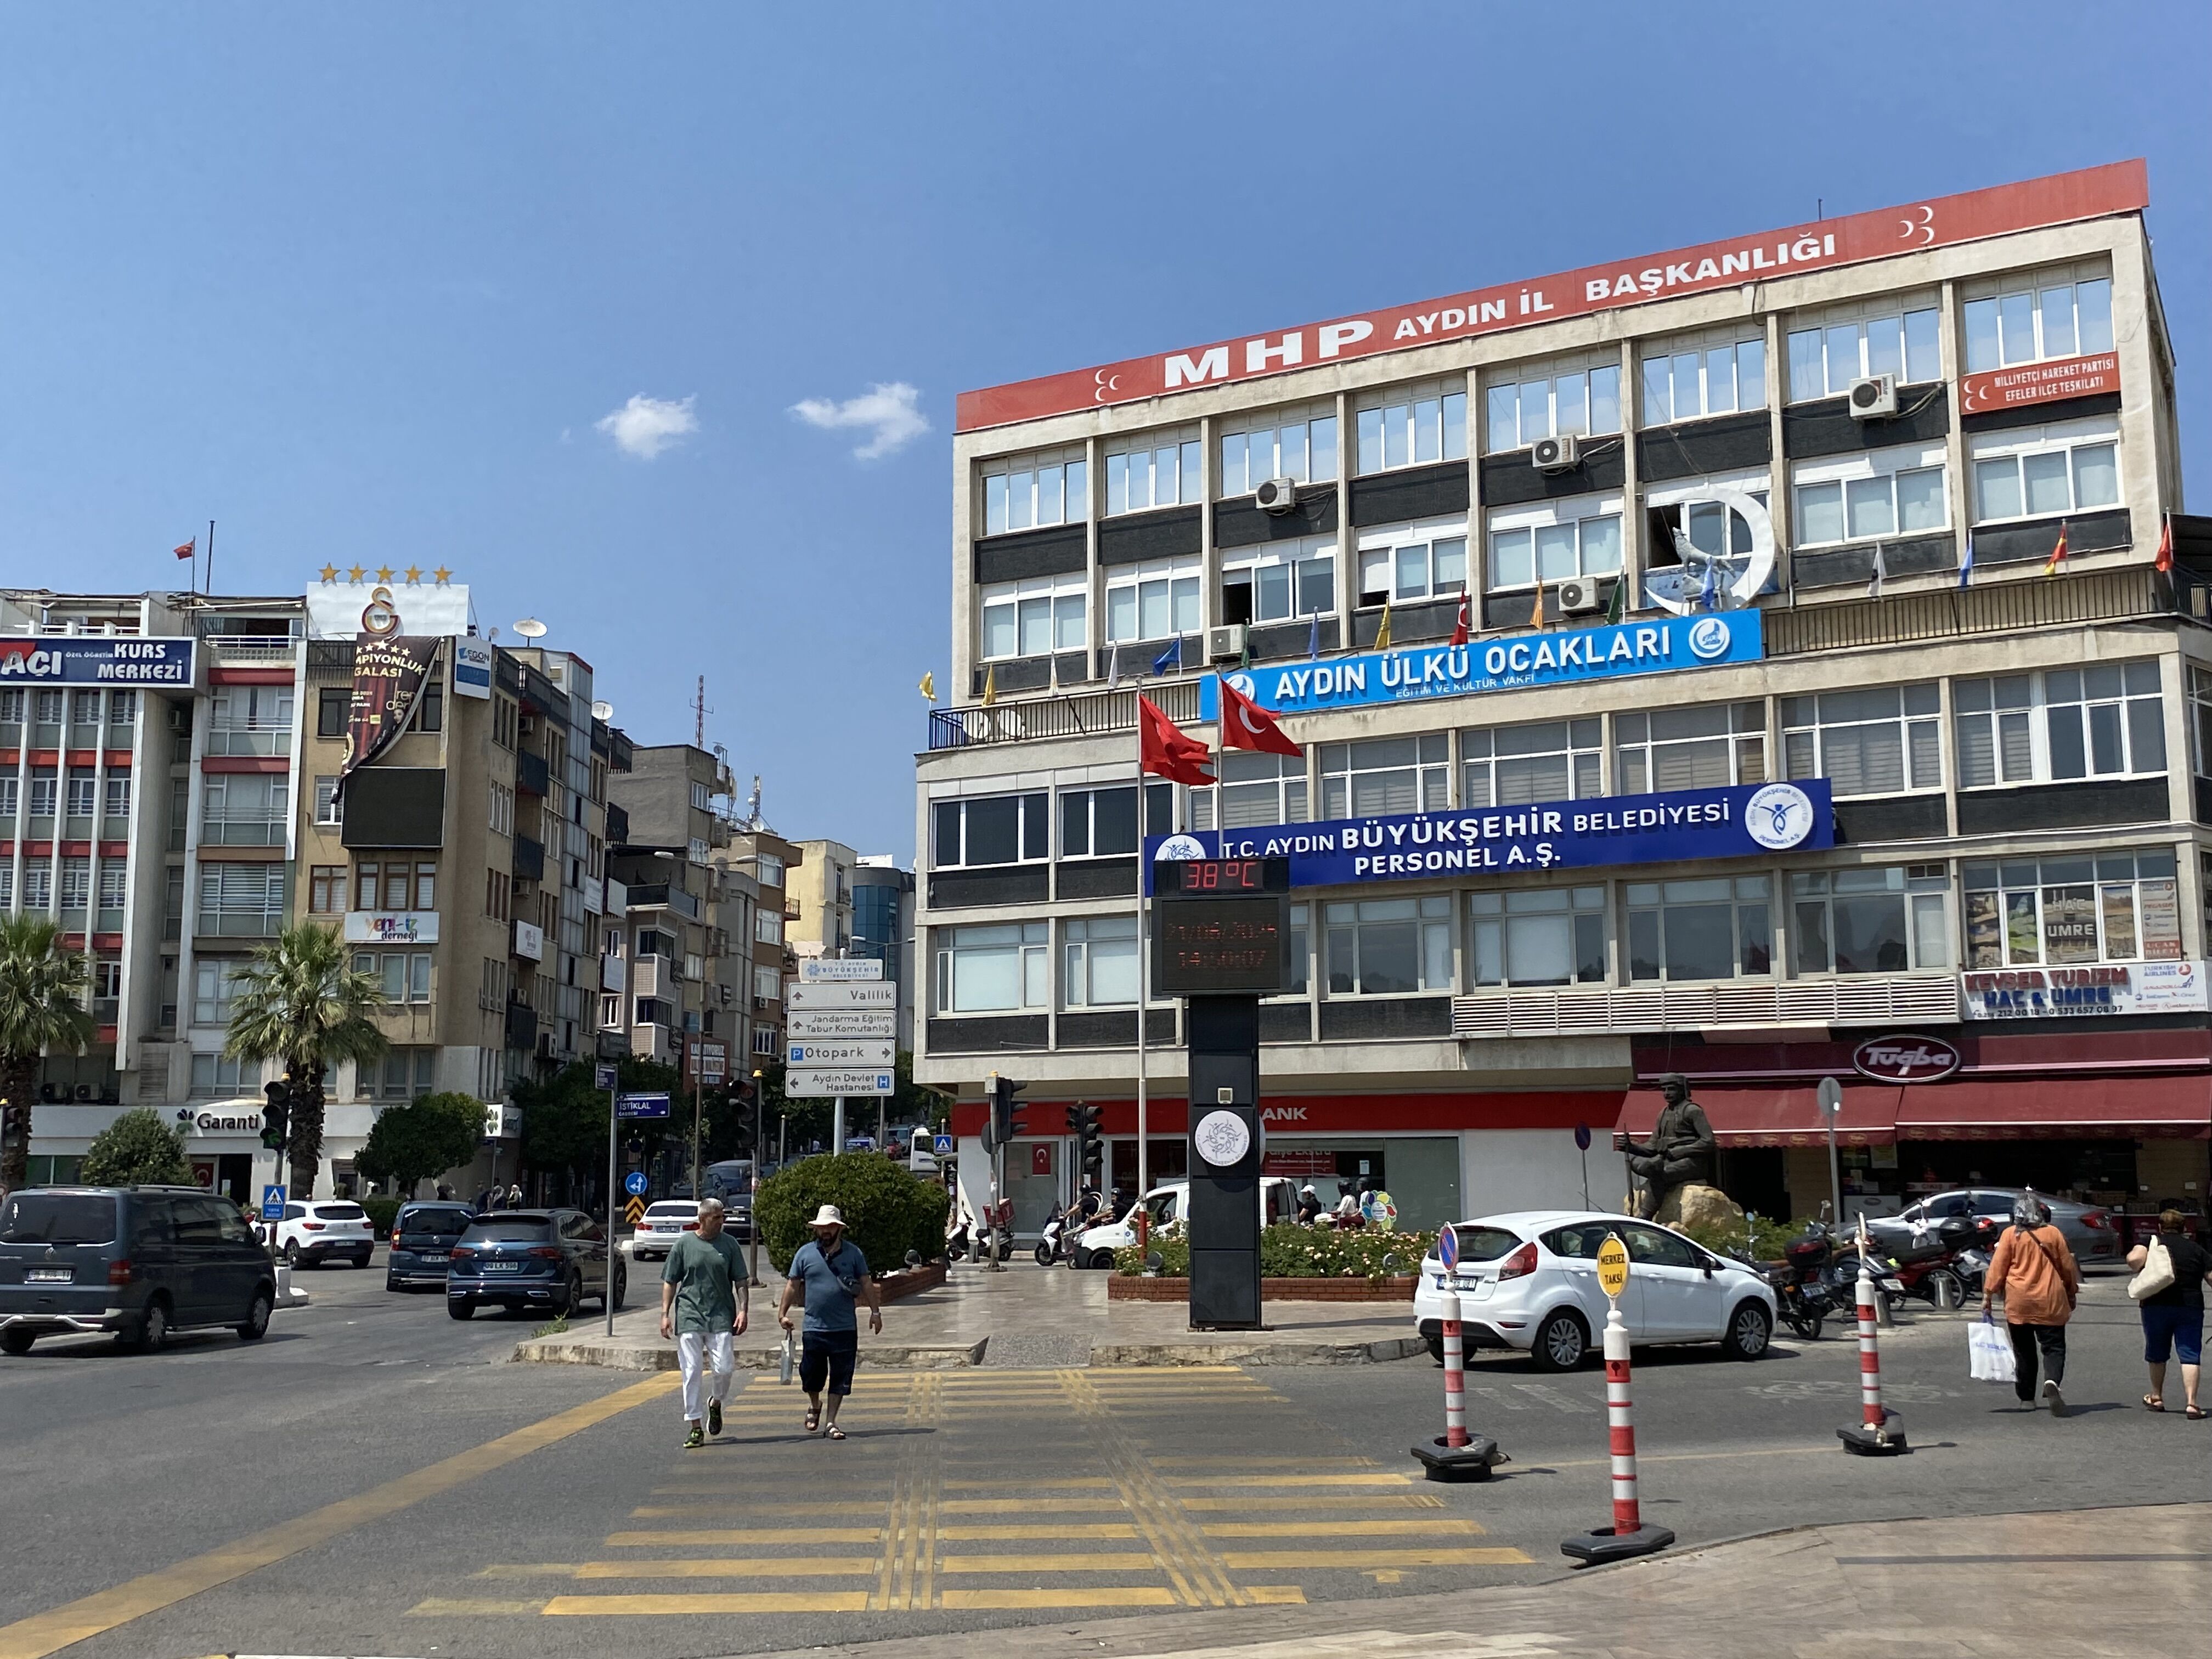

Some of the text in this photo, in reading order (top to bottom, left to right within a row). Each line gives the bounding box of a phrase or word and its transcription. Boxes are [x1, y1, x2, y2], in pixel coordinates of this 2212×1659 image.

[1165, 232, 1836, 388] MHP AYDIN İL BAŞKANLIĞI
[2042, 364, 2080, 380] HAREKET
[2081, 357, 2114, 374] PARTİSİ
[2005, 386, 2037, 402] EFELER
[2059, 376, 2103, 393] TEŞKİLATI
[114, 644, 166, 658] KURS
[1, 650, 62, 677] AÇI
[97, 660, 183, 679] MERKEZİ
[1274, 627, 1670, 699] AYDIN ÜLKÜ OCAKLARI
[1435, 685, 1451, 693] VE
[1453, 677, 1497, 691] KÜLTÜR
[1502, 674, 1536, 686] VAKFI
[1264, 834, 1334, 855] AYDIN
[1342, 806, 1564, 849] BÜYÜKŞEHİR
[1573, 797, 1730, 832] BELEDİYESİ
[1355, 842, 1561, 876] PERSONEL A.Ş.
[1186, 863, 1218, 888] 38
[2052, 899, 2085, 911] HAC
[2047, 923, 2095, 937] UMRE
[1964, 971, 2045, 992] KEVSER
[850, 990, 892, 1000] Valilik
[1983, 990, 2027, 1008] HAC
[2050, 988, 2111, 1006] UMRE
[835, 1024, 892, 1034] Komutanlığı
[862, 1015, 892, 1024] Eğitim
[793, 1047, 865, 1060] P Otopark
[1865, 1046, 1951, 1076] Tuğba
[812, 1074, 840, 1084] Aydın
[844, 1074, 874, 1082] Devlet
[826, 1084, 874, 1092] Hastanesi
[197, 1113, 259, 1130] Garanti
[1600, 1253, 1626, 1265] MERKEZ
[1605, 1270, 1623, 1285] TAKSİ
